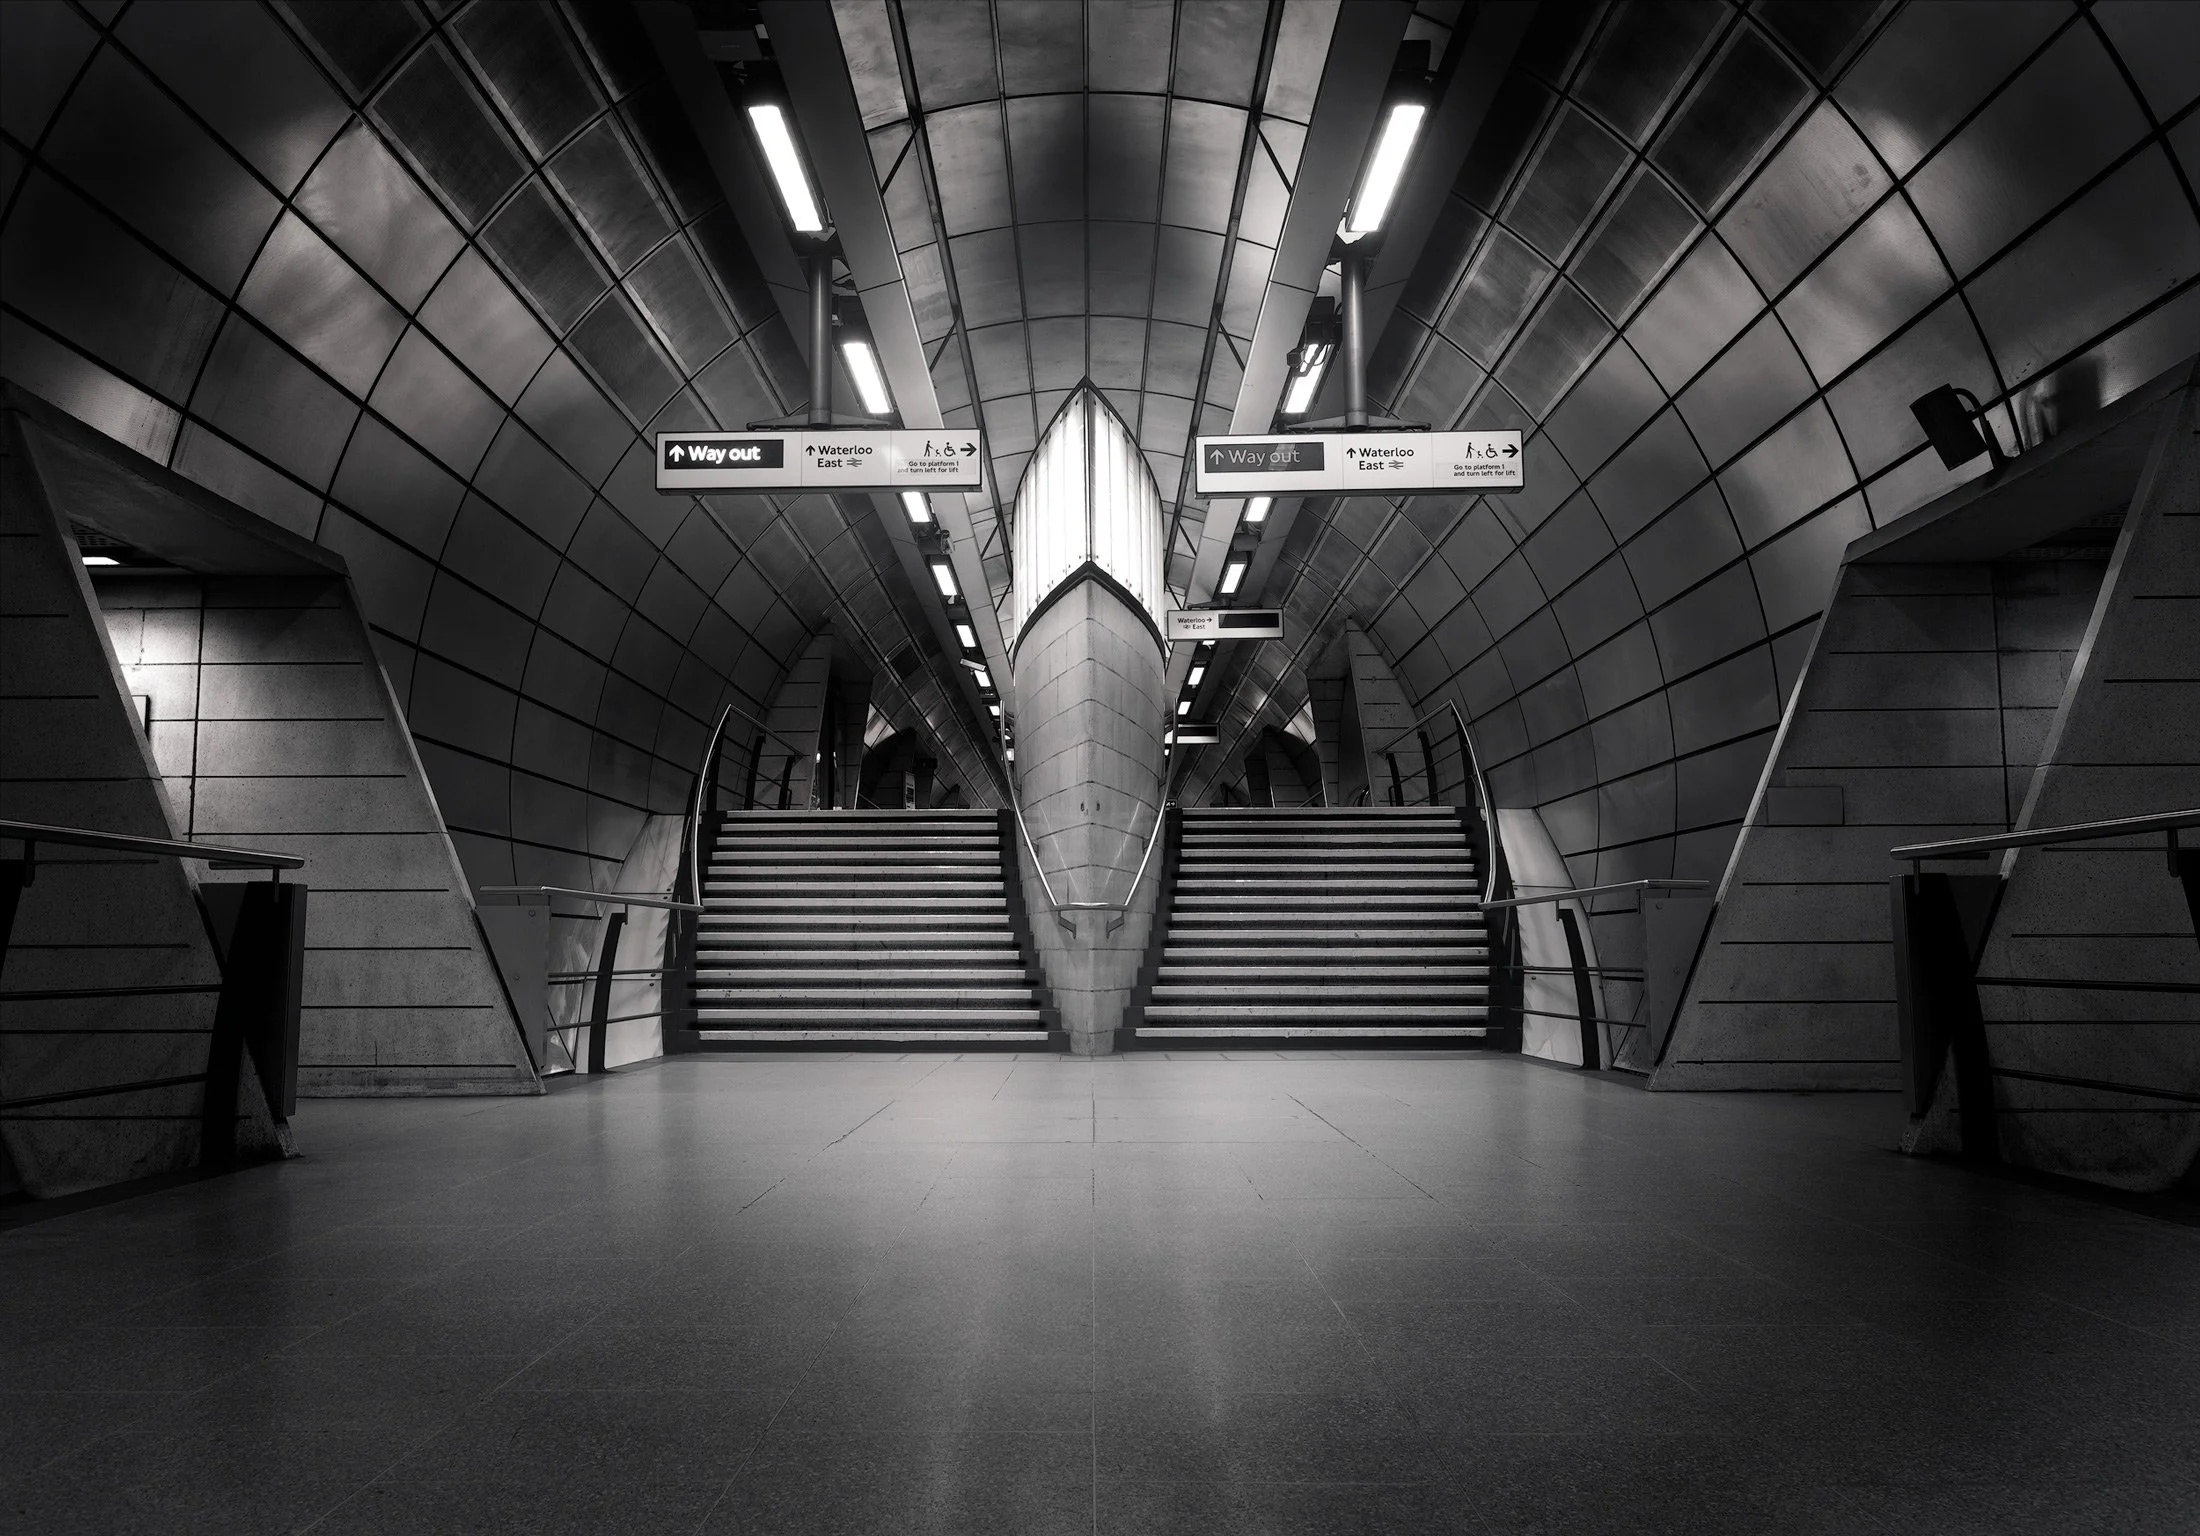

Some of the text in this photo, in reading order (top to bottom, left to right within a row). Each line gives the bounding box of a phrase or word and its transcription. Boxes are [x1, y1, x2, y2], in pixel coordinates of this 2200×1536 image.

[688, 445, 761, 464] Way out
[818, 445, 873, 455] Waterloo
[1359, 447, 1415, 458] Waterloo
[817, 458, 843, 468] East
[1228, 449, 1300, 467] Way out
[1359, 460, 1384, 470] East
